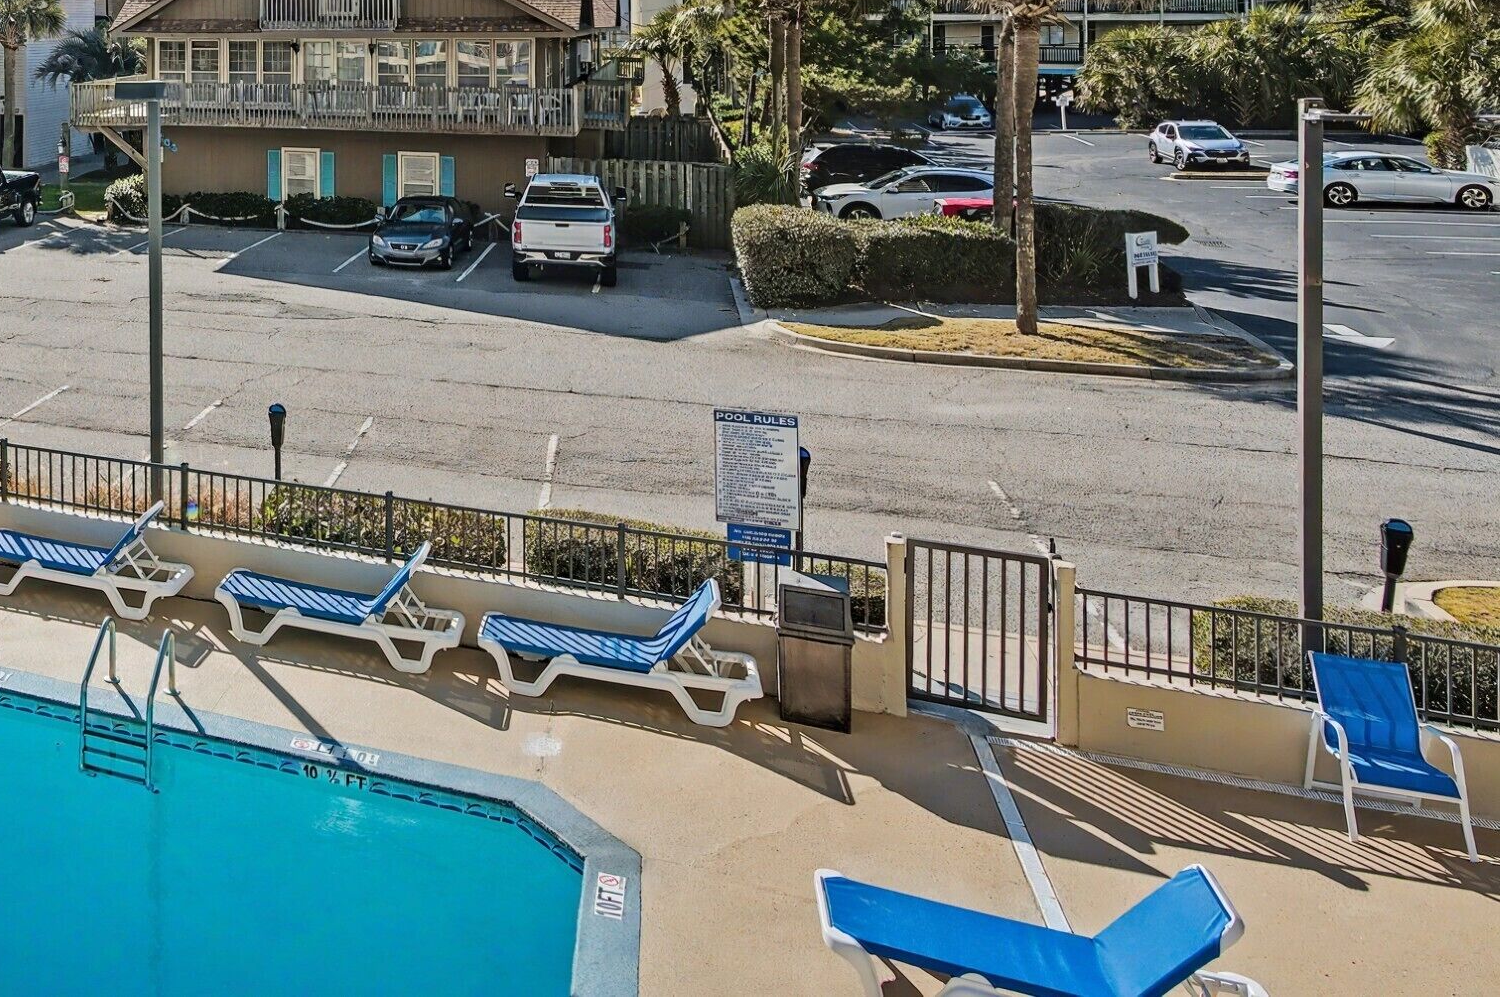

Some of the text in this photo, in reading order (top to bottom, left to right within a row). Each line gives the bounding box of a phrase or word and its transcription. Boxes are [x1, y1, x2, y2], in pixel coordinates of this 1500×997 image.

[716, 412, 796, 426] POOL RULES
[303, 765, 318, 779] 10
[346, 774, 366, 789] FT
